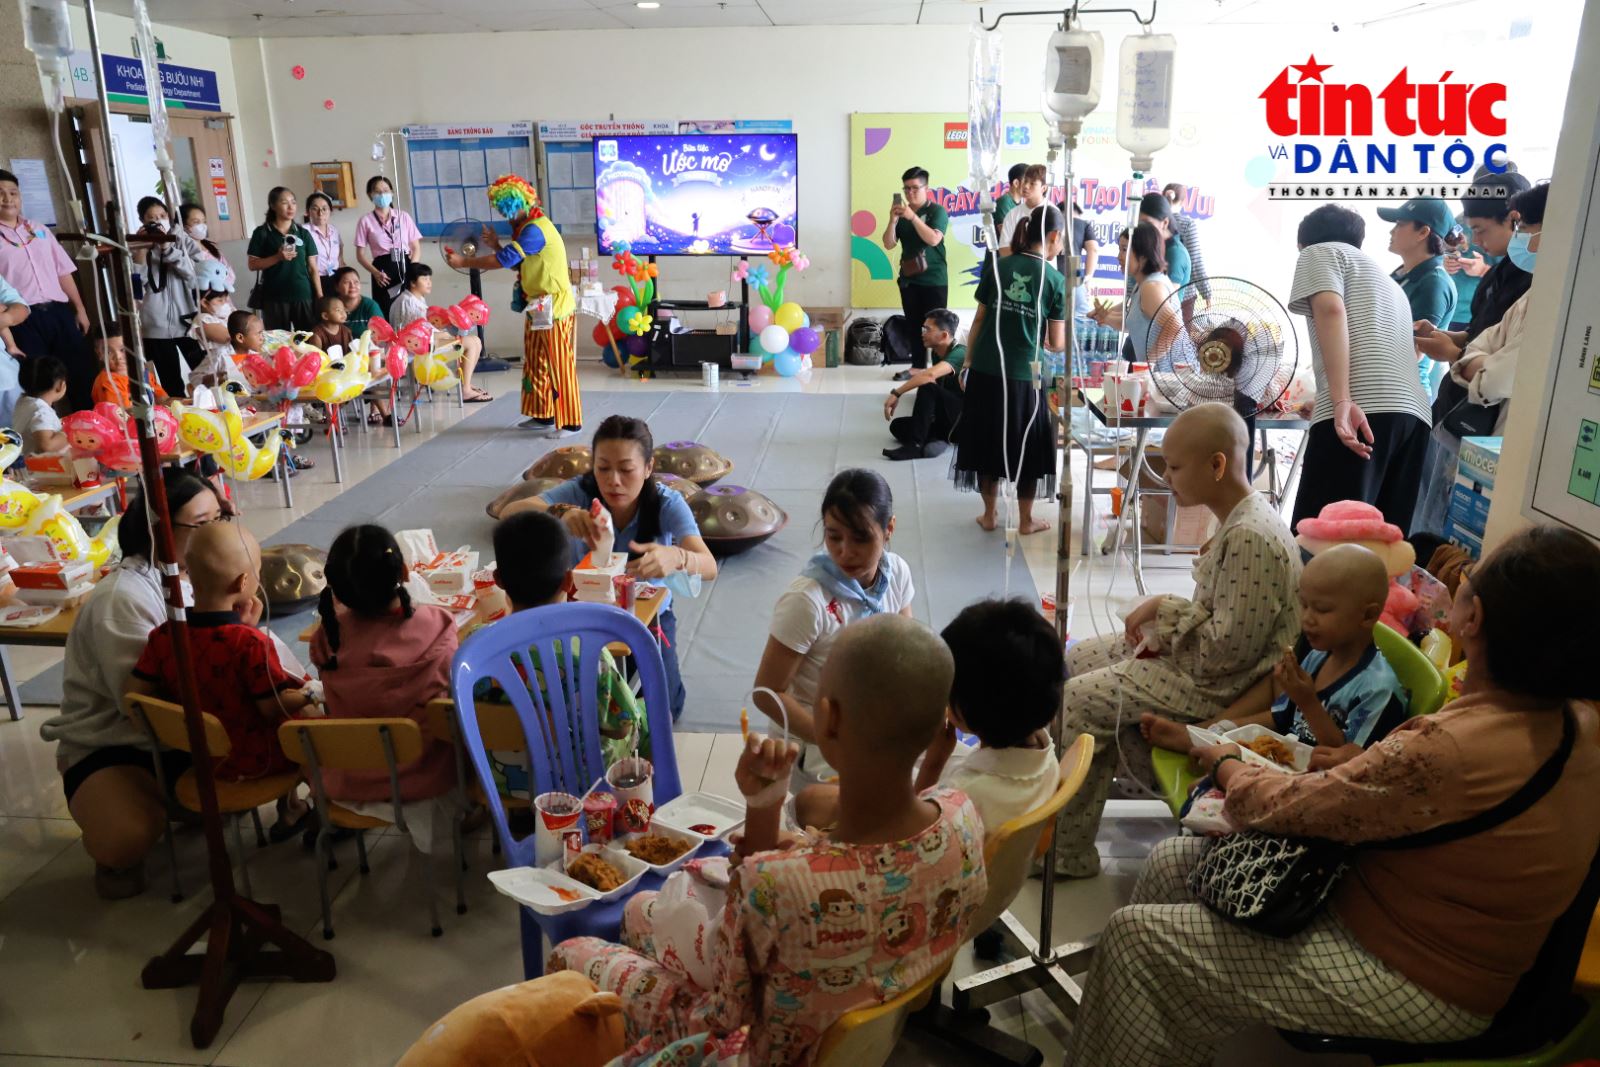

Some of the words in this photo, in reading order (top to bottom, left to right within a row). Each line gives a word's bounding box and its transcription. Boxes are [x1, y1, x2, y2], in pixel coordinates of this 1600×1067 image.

[116, 64, 144, 79] KHOA
[190, 75, 204, 88] NHI
[174, 88, 201, 98] Department
